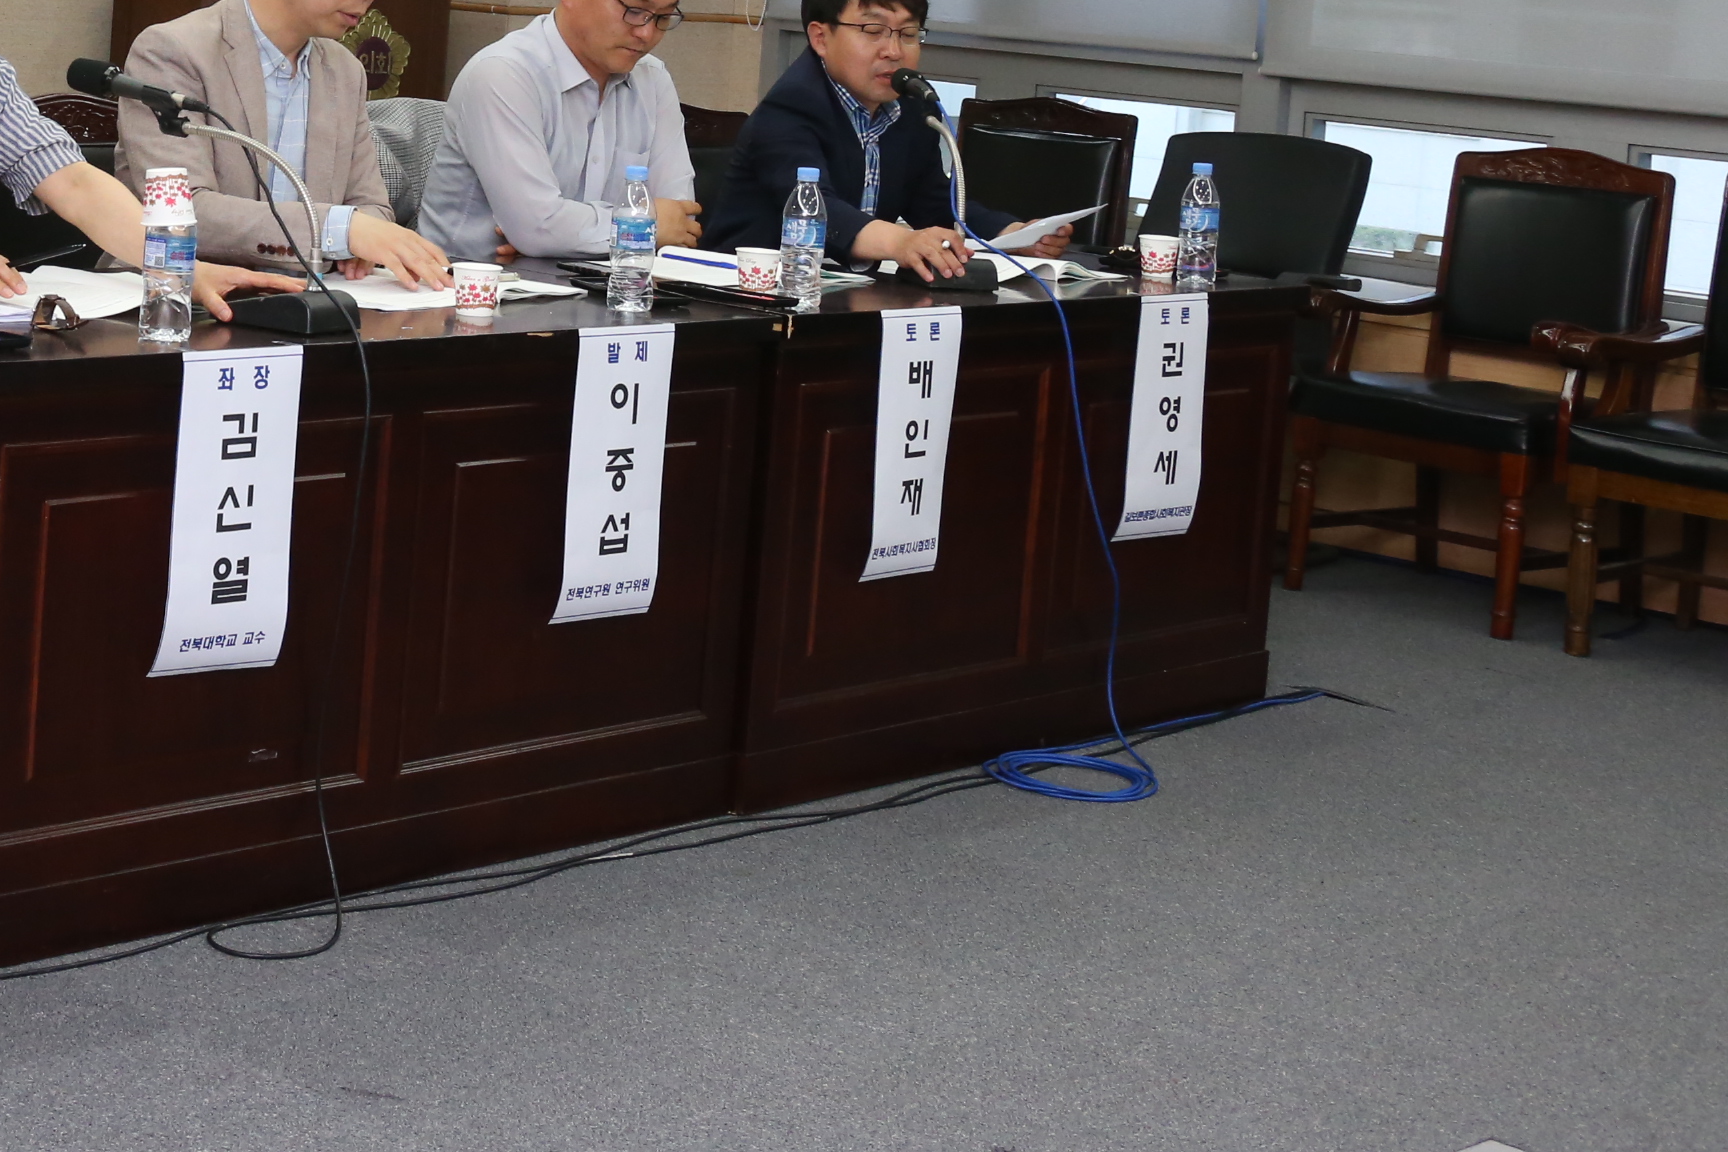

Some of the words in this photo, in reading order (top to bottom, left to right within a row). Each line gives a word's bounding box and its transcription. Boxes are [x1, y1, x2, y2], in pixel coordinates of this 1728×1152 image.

[565, 583, 612, 602] 전북연구원
[614, 577, 651, 595] 연구위원
[179, 633, 238, 653] 전북대학교
[242, 630, 266, 646] 교수
